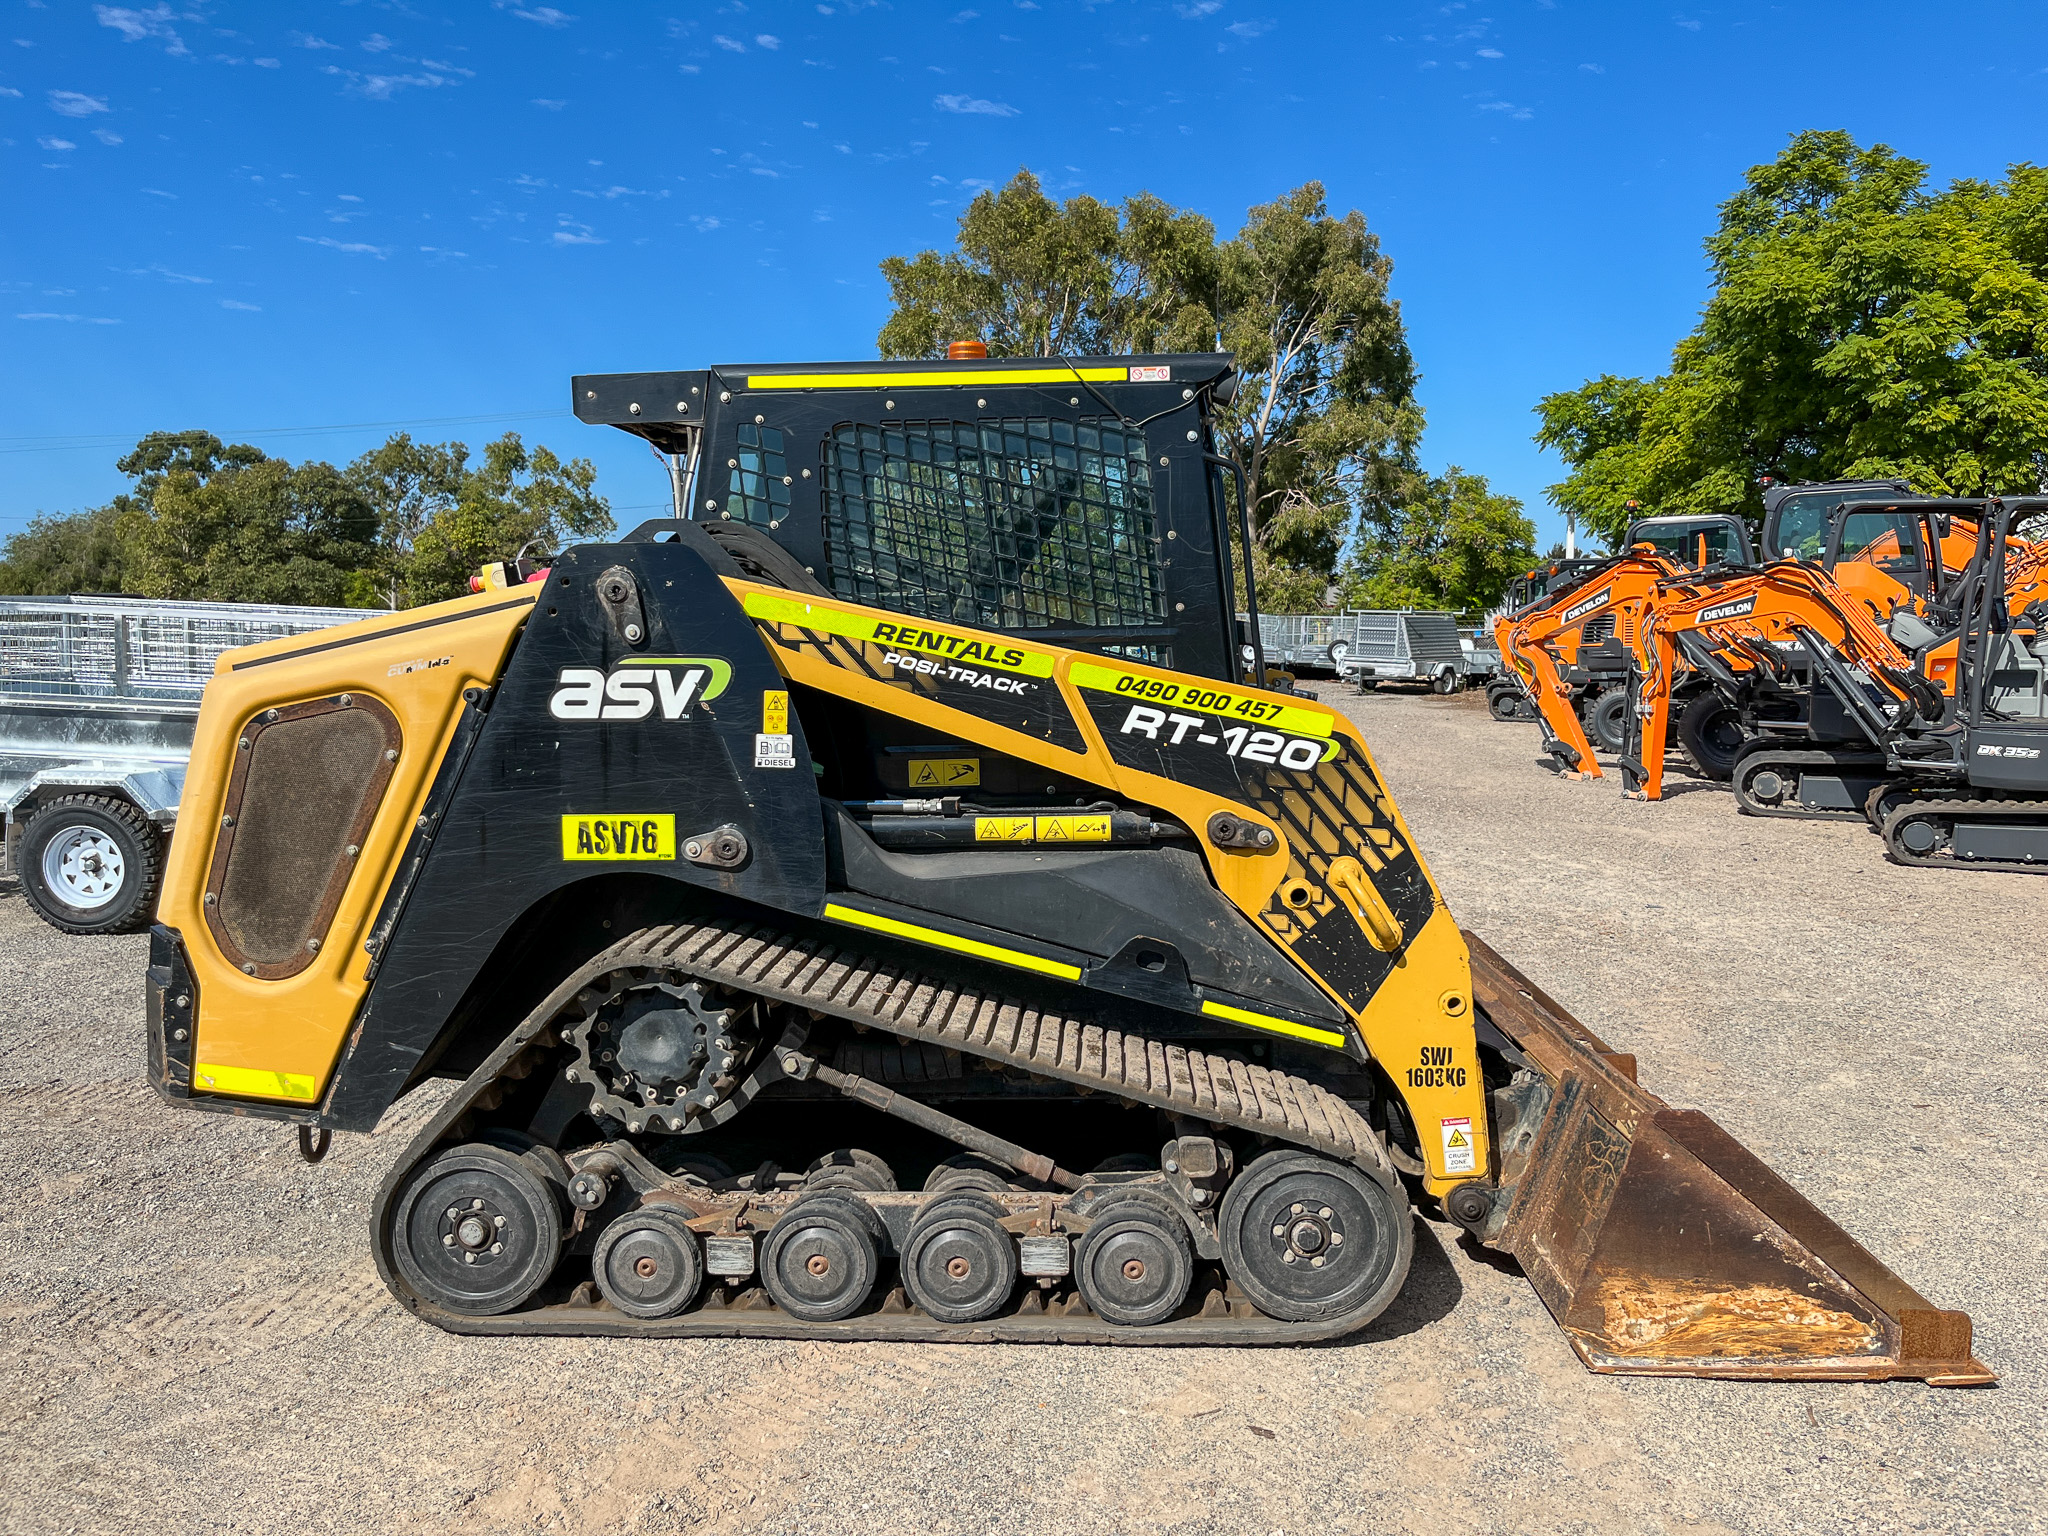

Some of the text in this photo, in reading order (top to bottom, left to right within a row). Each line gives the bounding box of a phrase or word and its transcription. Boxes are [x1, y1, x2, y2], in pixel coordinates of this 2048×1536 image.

[1568, 593, 1608, 620] DEVELON
[1704, 602, 1752, 620] DEVELON
[872, 622, 1025, 666] RENTALS
[1115, 675, 1284, 721] 0490 900 457
[1120, 704, 1322, 770] RT-120
[764, 759, 794, 767] DIESEL
[576, 820, 659, 855] ASV76
[1405, 1067, 1467, 1088] 1603KG
